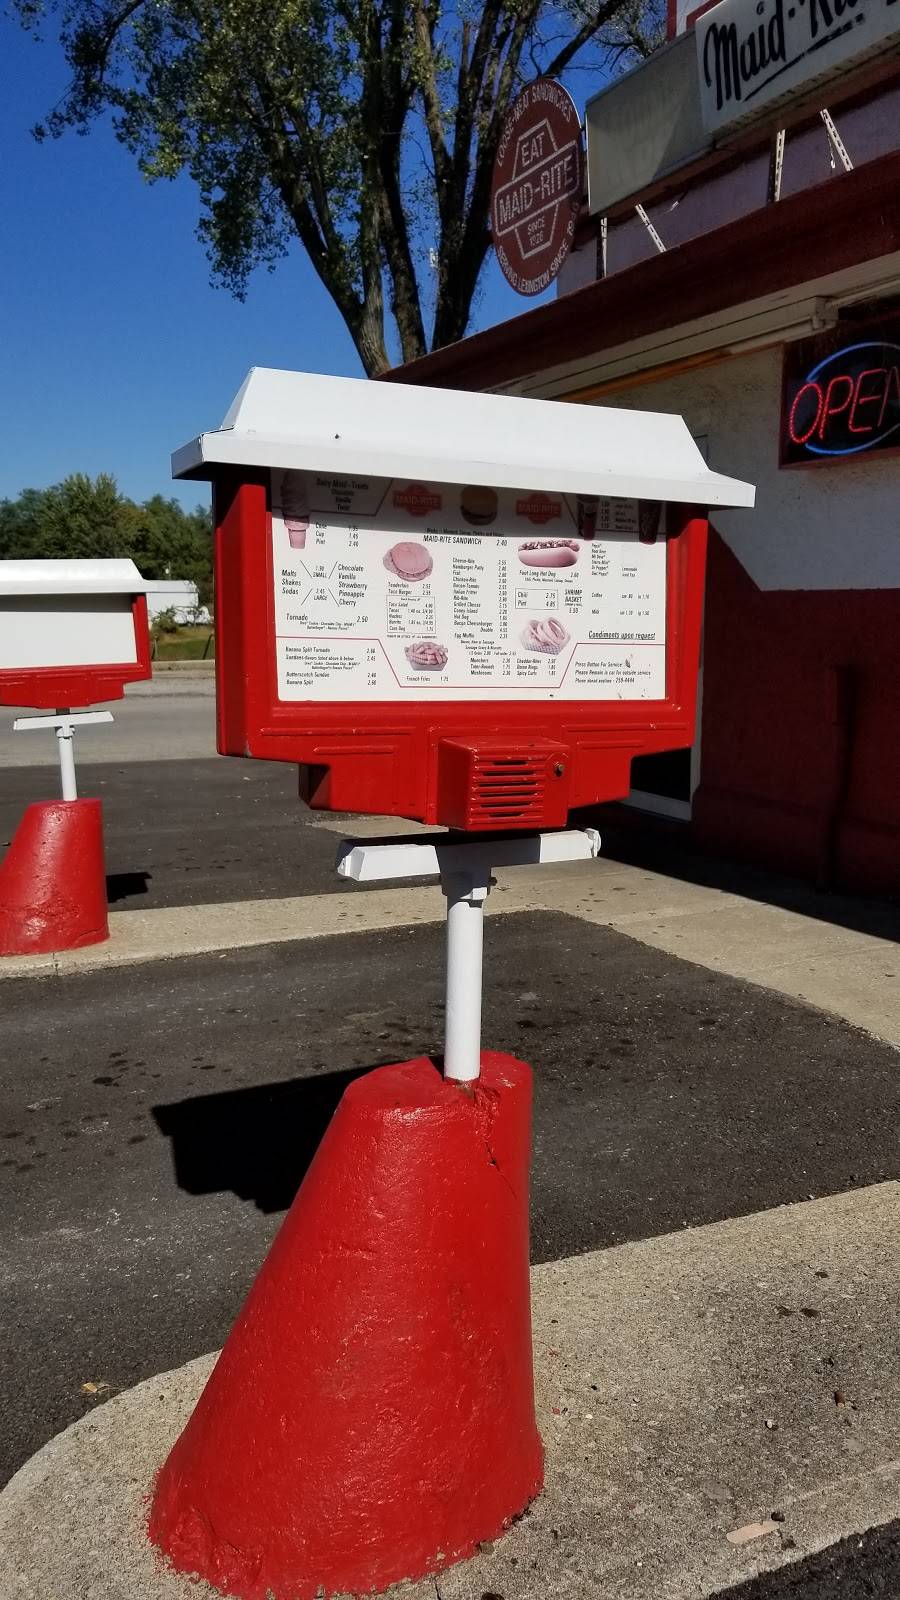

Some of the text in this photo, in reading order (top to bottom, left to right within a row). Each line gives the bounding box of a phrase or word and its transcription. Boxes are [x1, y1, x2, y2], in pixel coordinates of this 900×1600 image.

[497, 83, 571, 167] LOOSE-MEAT SANDWICHES
[521, 132, 545, 167] EAT
[500, 154, 573, 225] MAID-RITE
[528, 215, 546, 234] SINCE
[518, 269, 550, 293] LEXINGTON
[549, 239, 568, 276] SINCE
[790, 365, 900, 443] OPEN
[423, 535, 452, 544] MAID-RITE
[452, 536, 482, 544] SANDWICH
[338, 564, 364, 572] Chocolate
[282, 578, 302, 586] Shakes
[338, 582, 368, 590] Strawberry
[338, 590, 365, 598] Pineapple
[286, 613, 309, 622] Tornado
